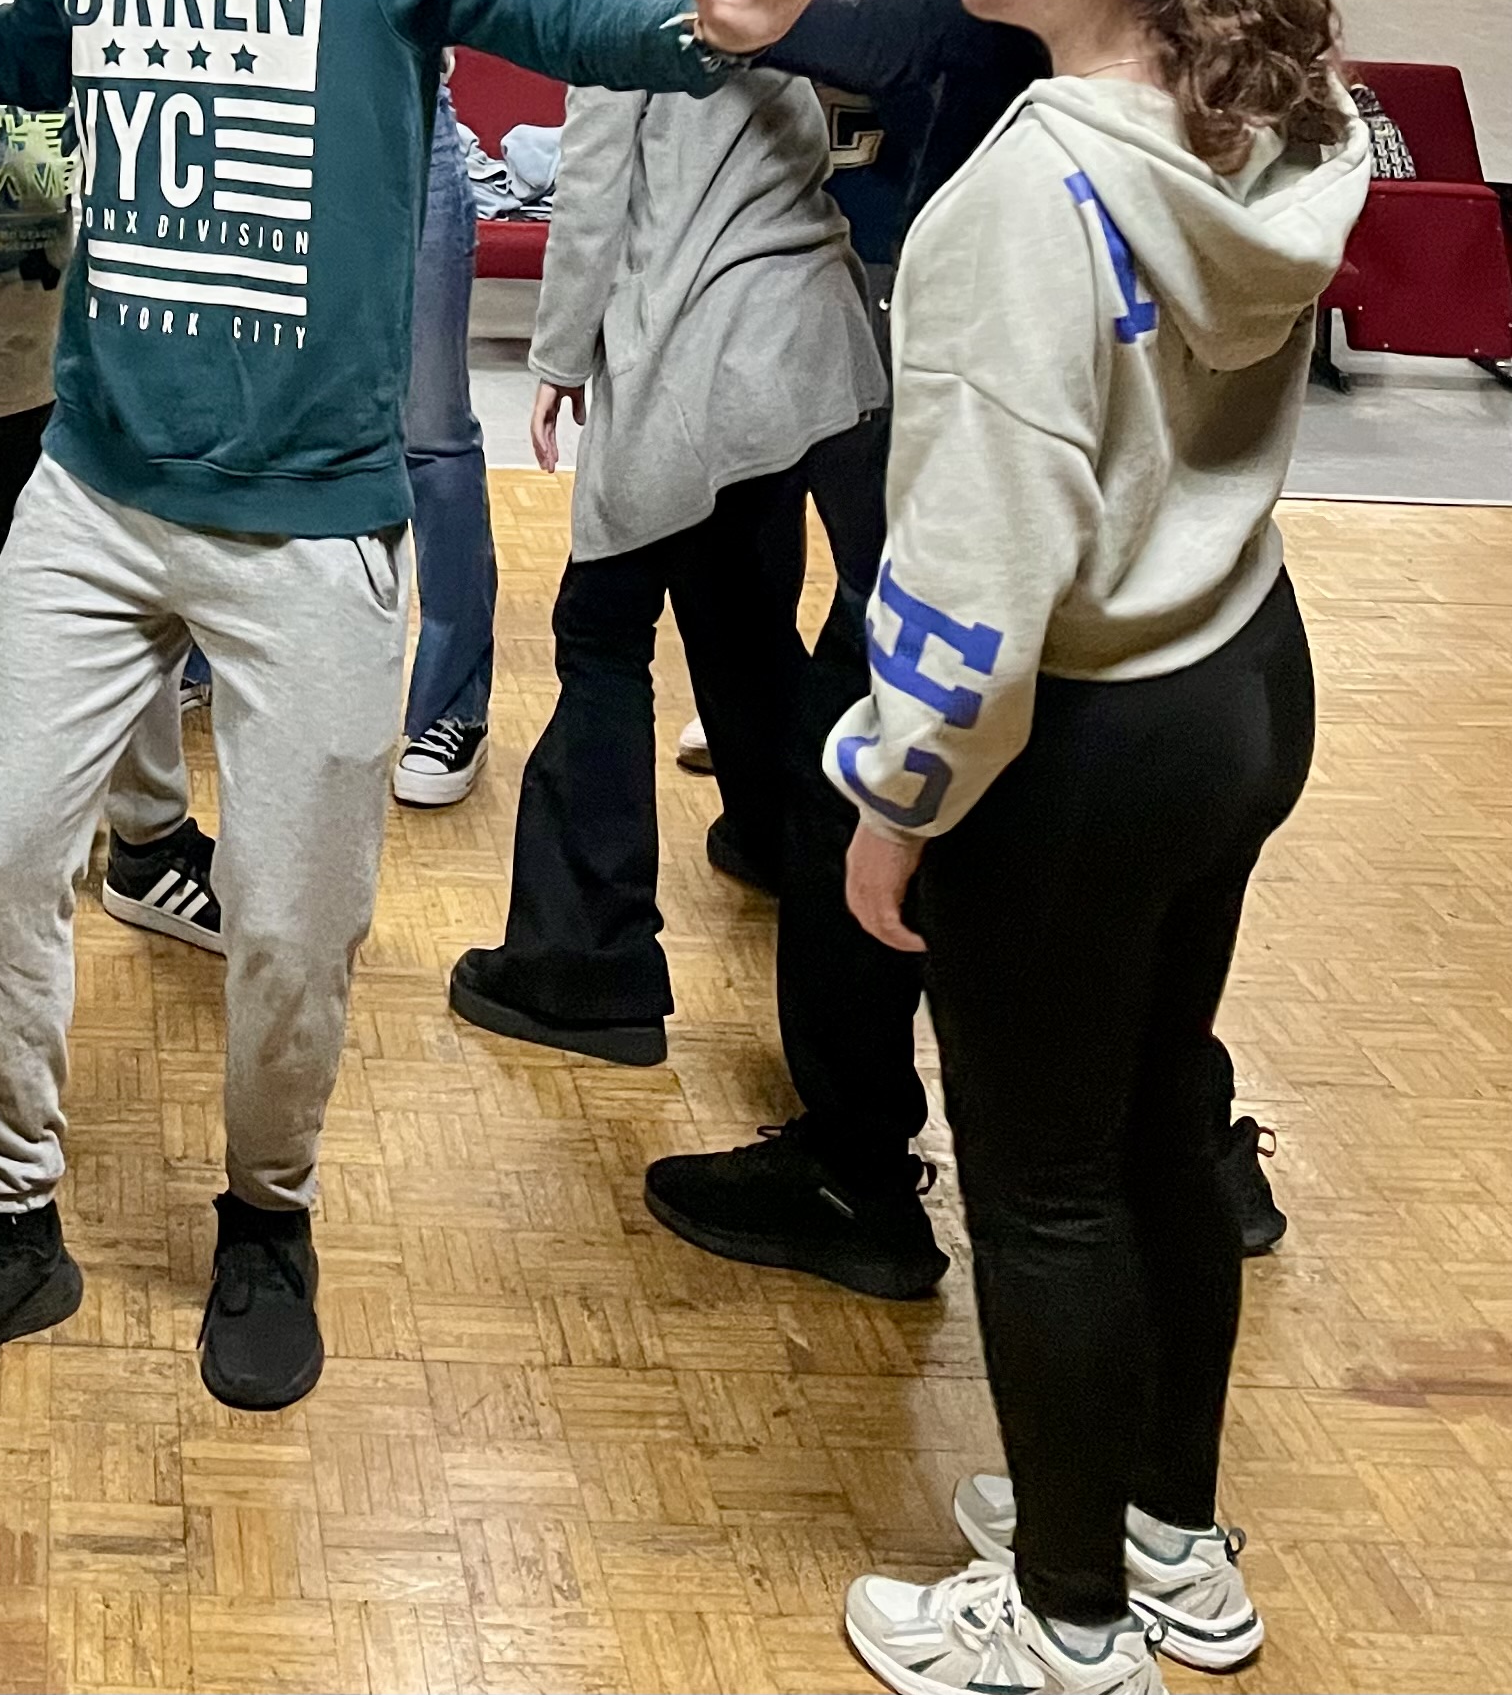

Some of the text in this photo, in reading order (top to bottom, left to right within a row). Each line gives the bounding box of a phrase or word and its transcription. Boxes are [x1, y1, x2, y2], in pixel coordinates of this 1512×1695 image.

[157, 215, 310, 254] DIVISION
[119, 304, 200, 337] YORK
[233, 317, 306, 349] CITY
